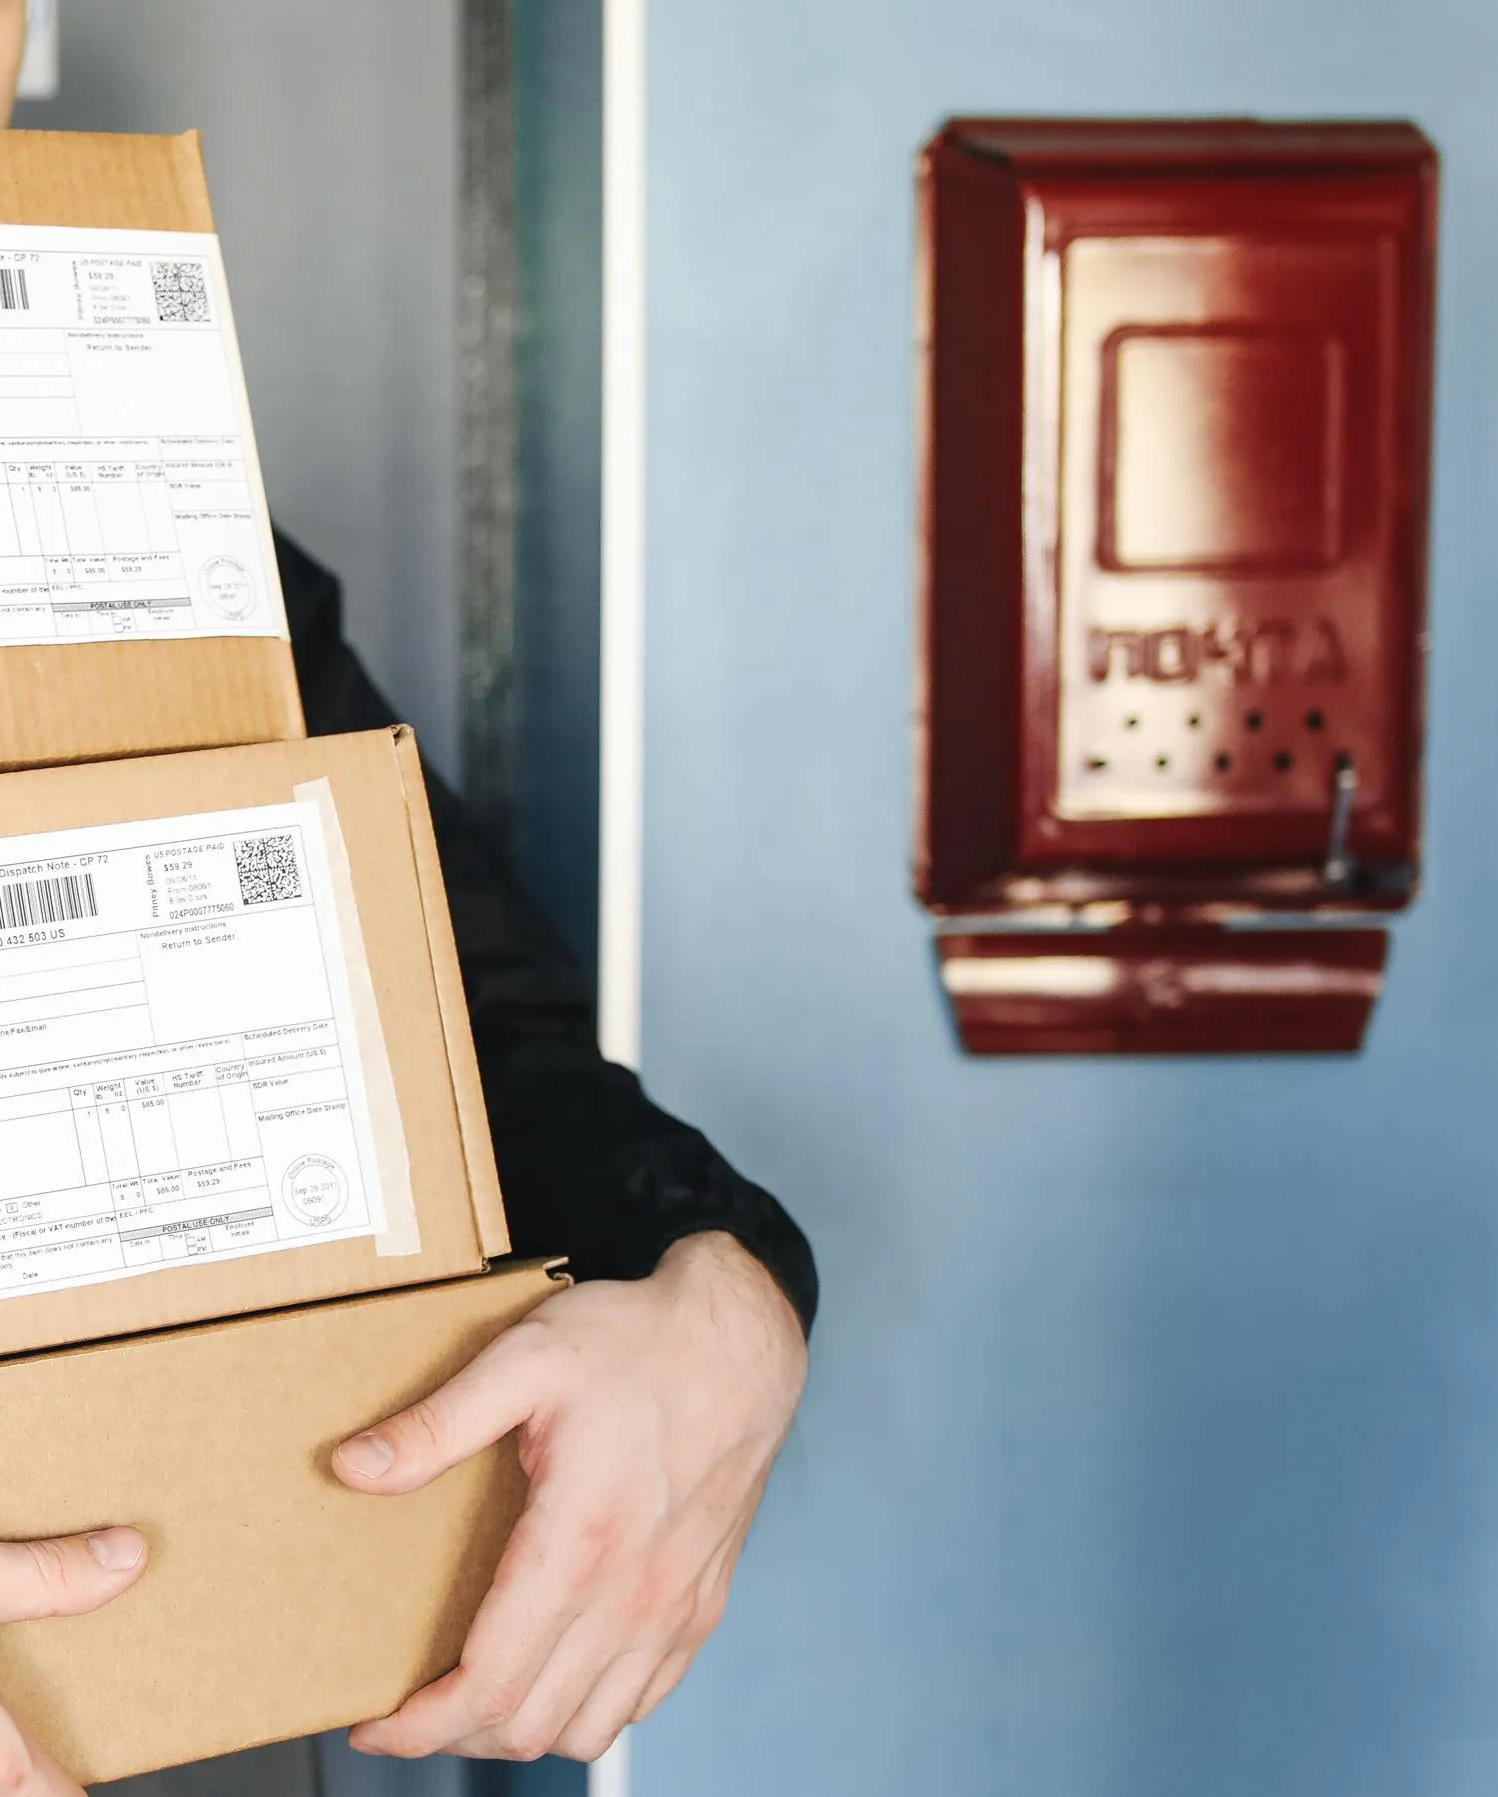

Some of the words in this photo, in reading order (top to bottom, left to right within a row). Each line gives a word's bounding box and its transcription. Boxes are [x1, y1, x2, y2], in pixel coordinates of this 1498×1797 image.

[13, 252, 28, 262] CP
[29, 253, 41, 263] 72
[152, 850, 164, 859] US
[164, 845, 204, 857] POSTAGE
[205, 842, 226, 851] PAID
[46, 861, 70, 870] Note
[79, 856, 96, 867] CP
[97, 854, 110, 864] 72
[163, 861, 194, 872] $59.29
[144, 854, 155, 886] Bowes
[150, 888, 160, 918] Pitney
[5, 934, 26, 945] 432
[27, 930, 48, 943] 503
[49, 928, 66, 940] US
[139, 929, 183, 939] Nondelivery
[161, 940, 192, 950] Return
[192, 938, 203, 946] to
[205, 933, 236, 944] Sender
[214, 1064, 245, 1074] Country
[95, 1082, 122, 1092] Weight
[134, 1078, 156, 1086] Value
[172, 1079, 202, 1088] Number
[269, 1078, 289, 1086] Value
[72, 1088, 87, 1096] Qty
[257, 1113, 284, 1122] Mailing
[306, 1106, 323, 1115] Date
[187, 1168, 217, 1177] Postage
[218, 1164, 233, 1172] and
[232, 1161, 252, 1169] Fees
[21, 1200, 41, 1209] Other
[95, 1216, 104, 1225] of
[161, 1220, 192, 1235] POSTAL
[191, 1217, 209, 1230] USE
[209, 1214, 231, 1227] ONLY
[22, 1271, 39, 1280] Date
